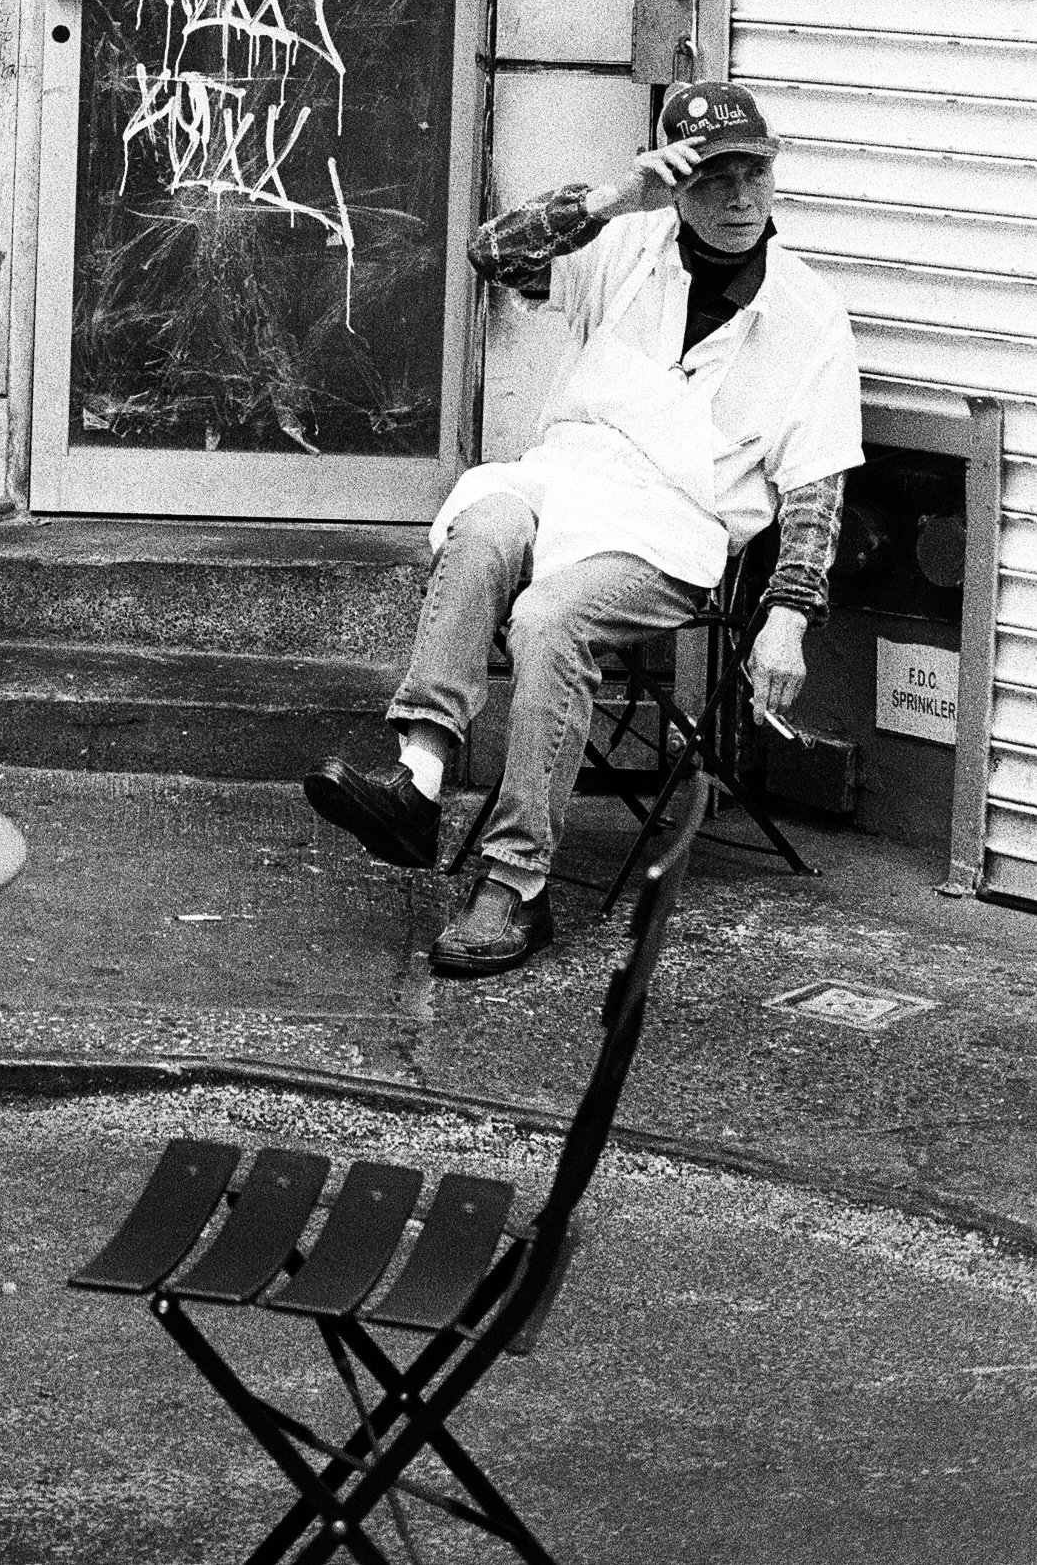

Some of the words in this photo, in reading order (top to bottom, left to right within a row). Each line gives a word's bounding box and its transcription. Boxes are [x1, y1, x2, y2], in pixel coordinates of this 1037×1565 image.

[676, 118, 710, 139] Nom
[713, 103, 747, 120] Wah
[892, 689, 956, 720] SPRINKLER
